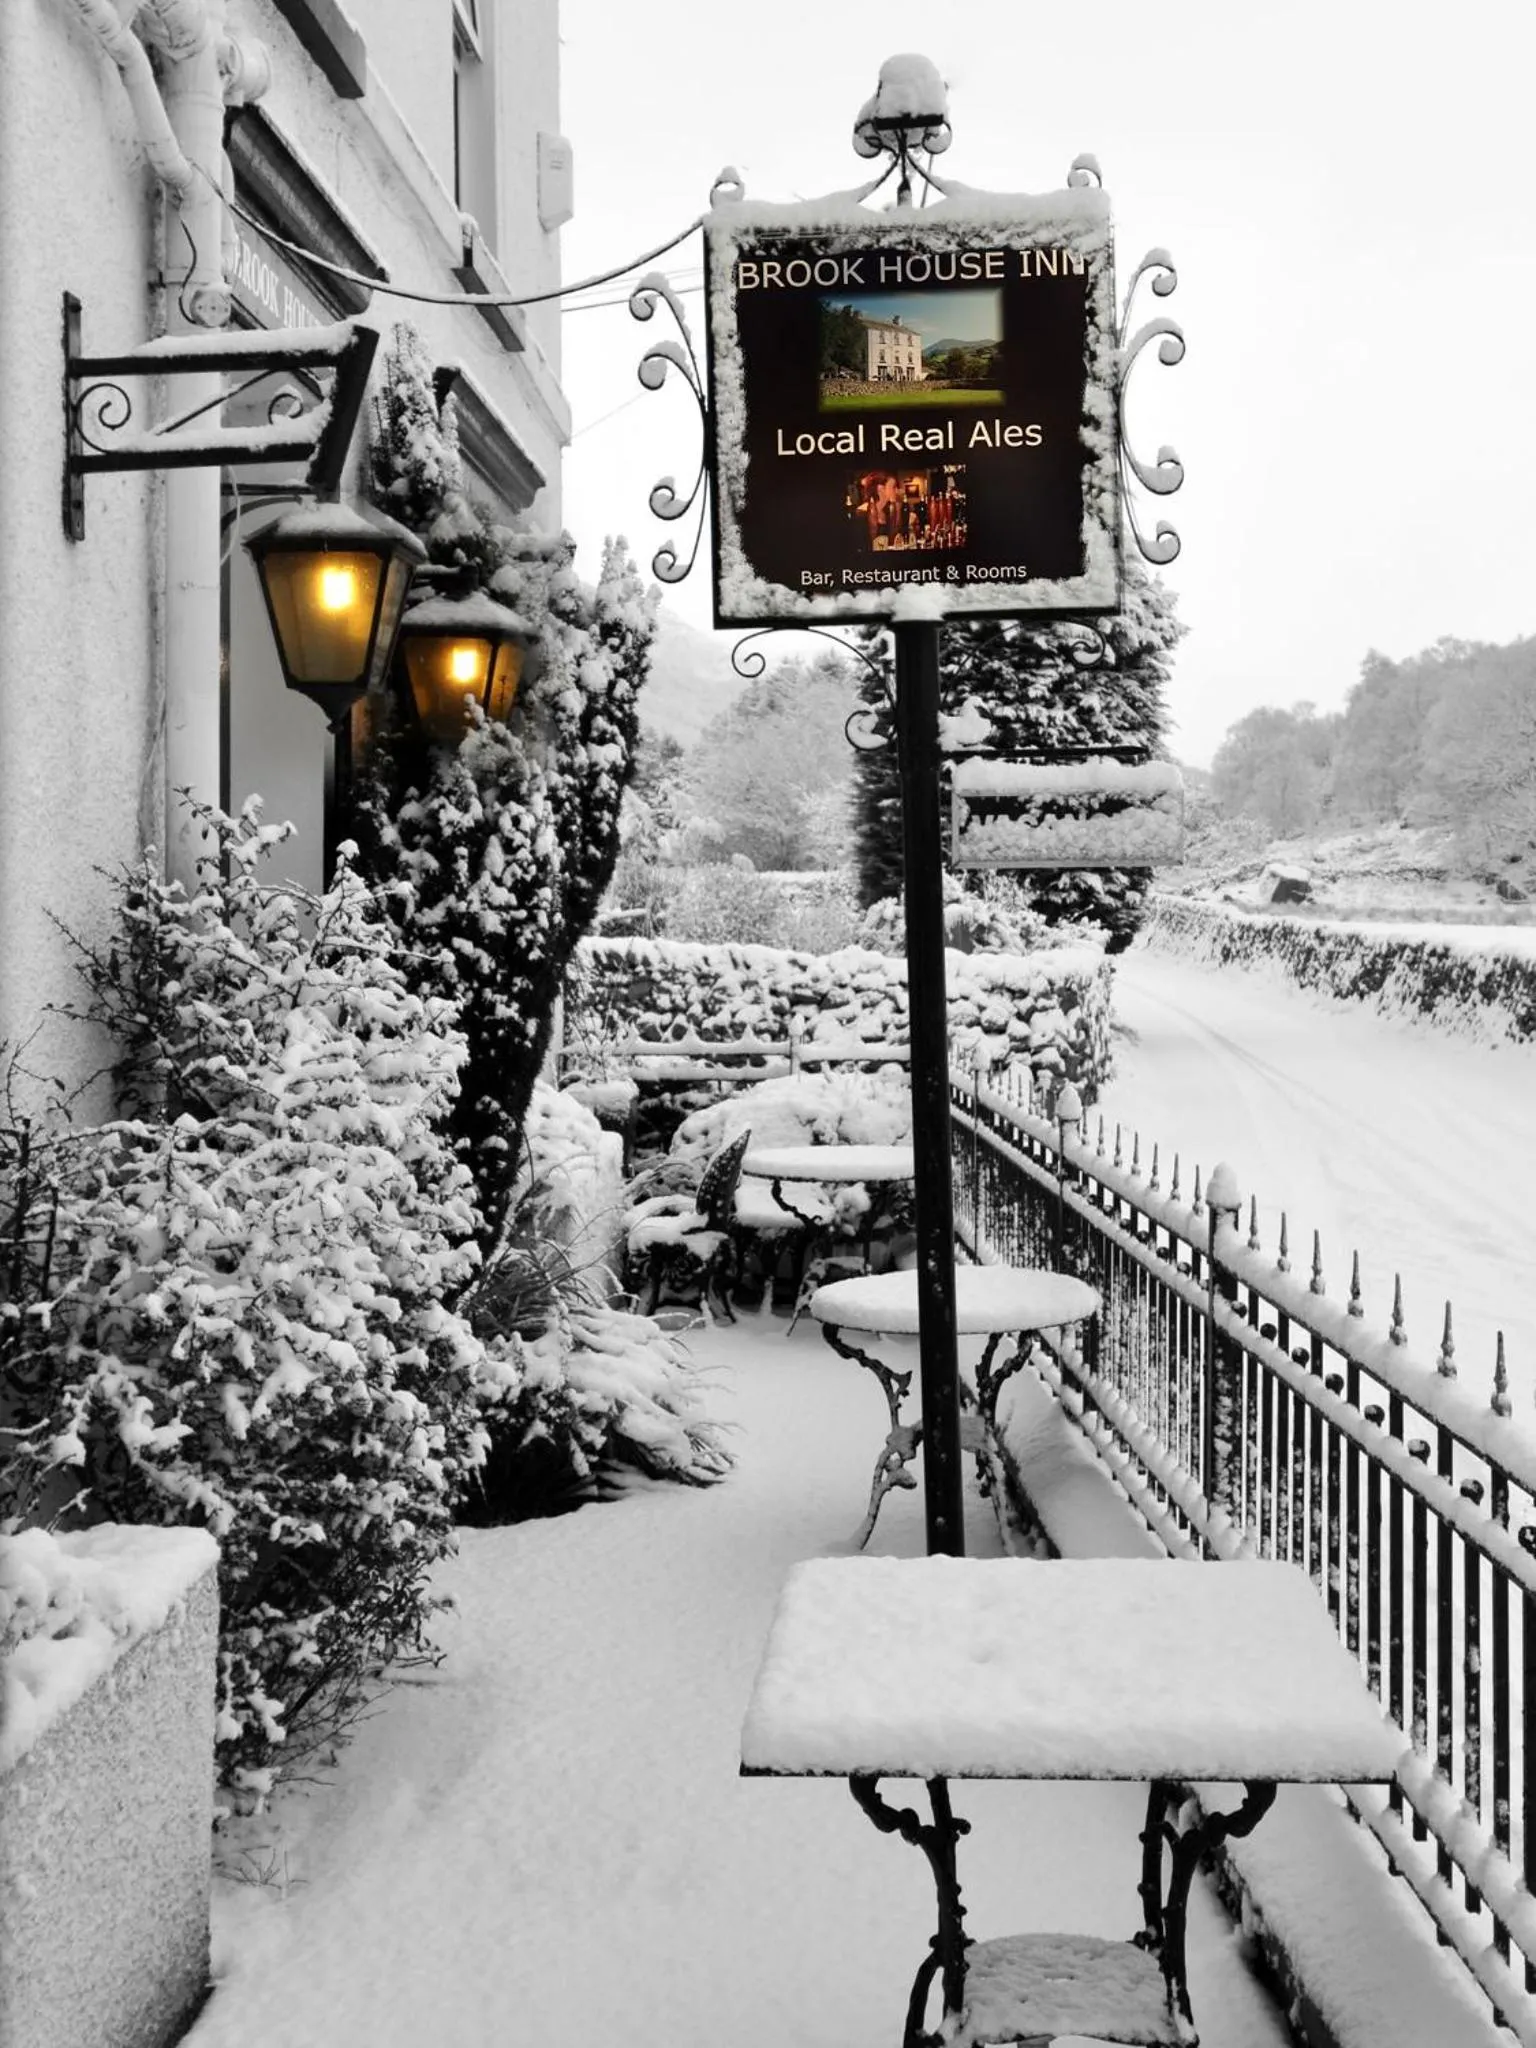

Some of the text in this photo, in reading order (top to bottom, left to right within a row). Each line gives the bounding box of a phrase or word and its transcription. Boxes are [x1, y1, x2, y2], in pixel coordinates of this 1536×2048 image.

[738, 248, 1086, 289] BROOK HOUSE INN
[777, 419, 1043, 456] Local Real Ales
[801, 564, 1028, 588] Bar, Restaurant & Rooms
